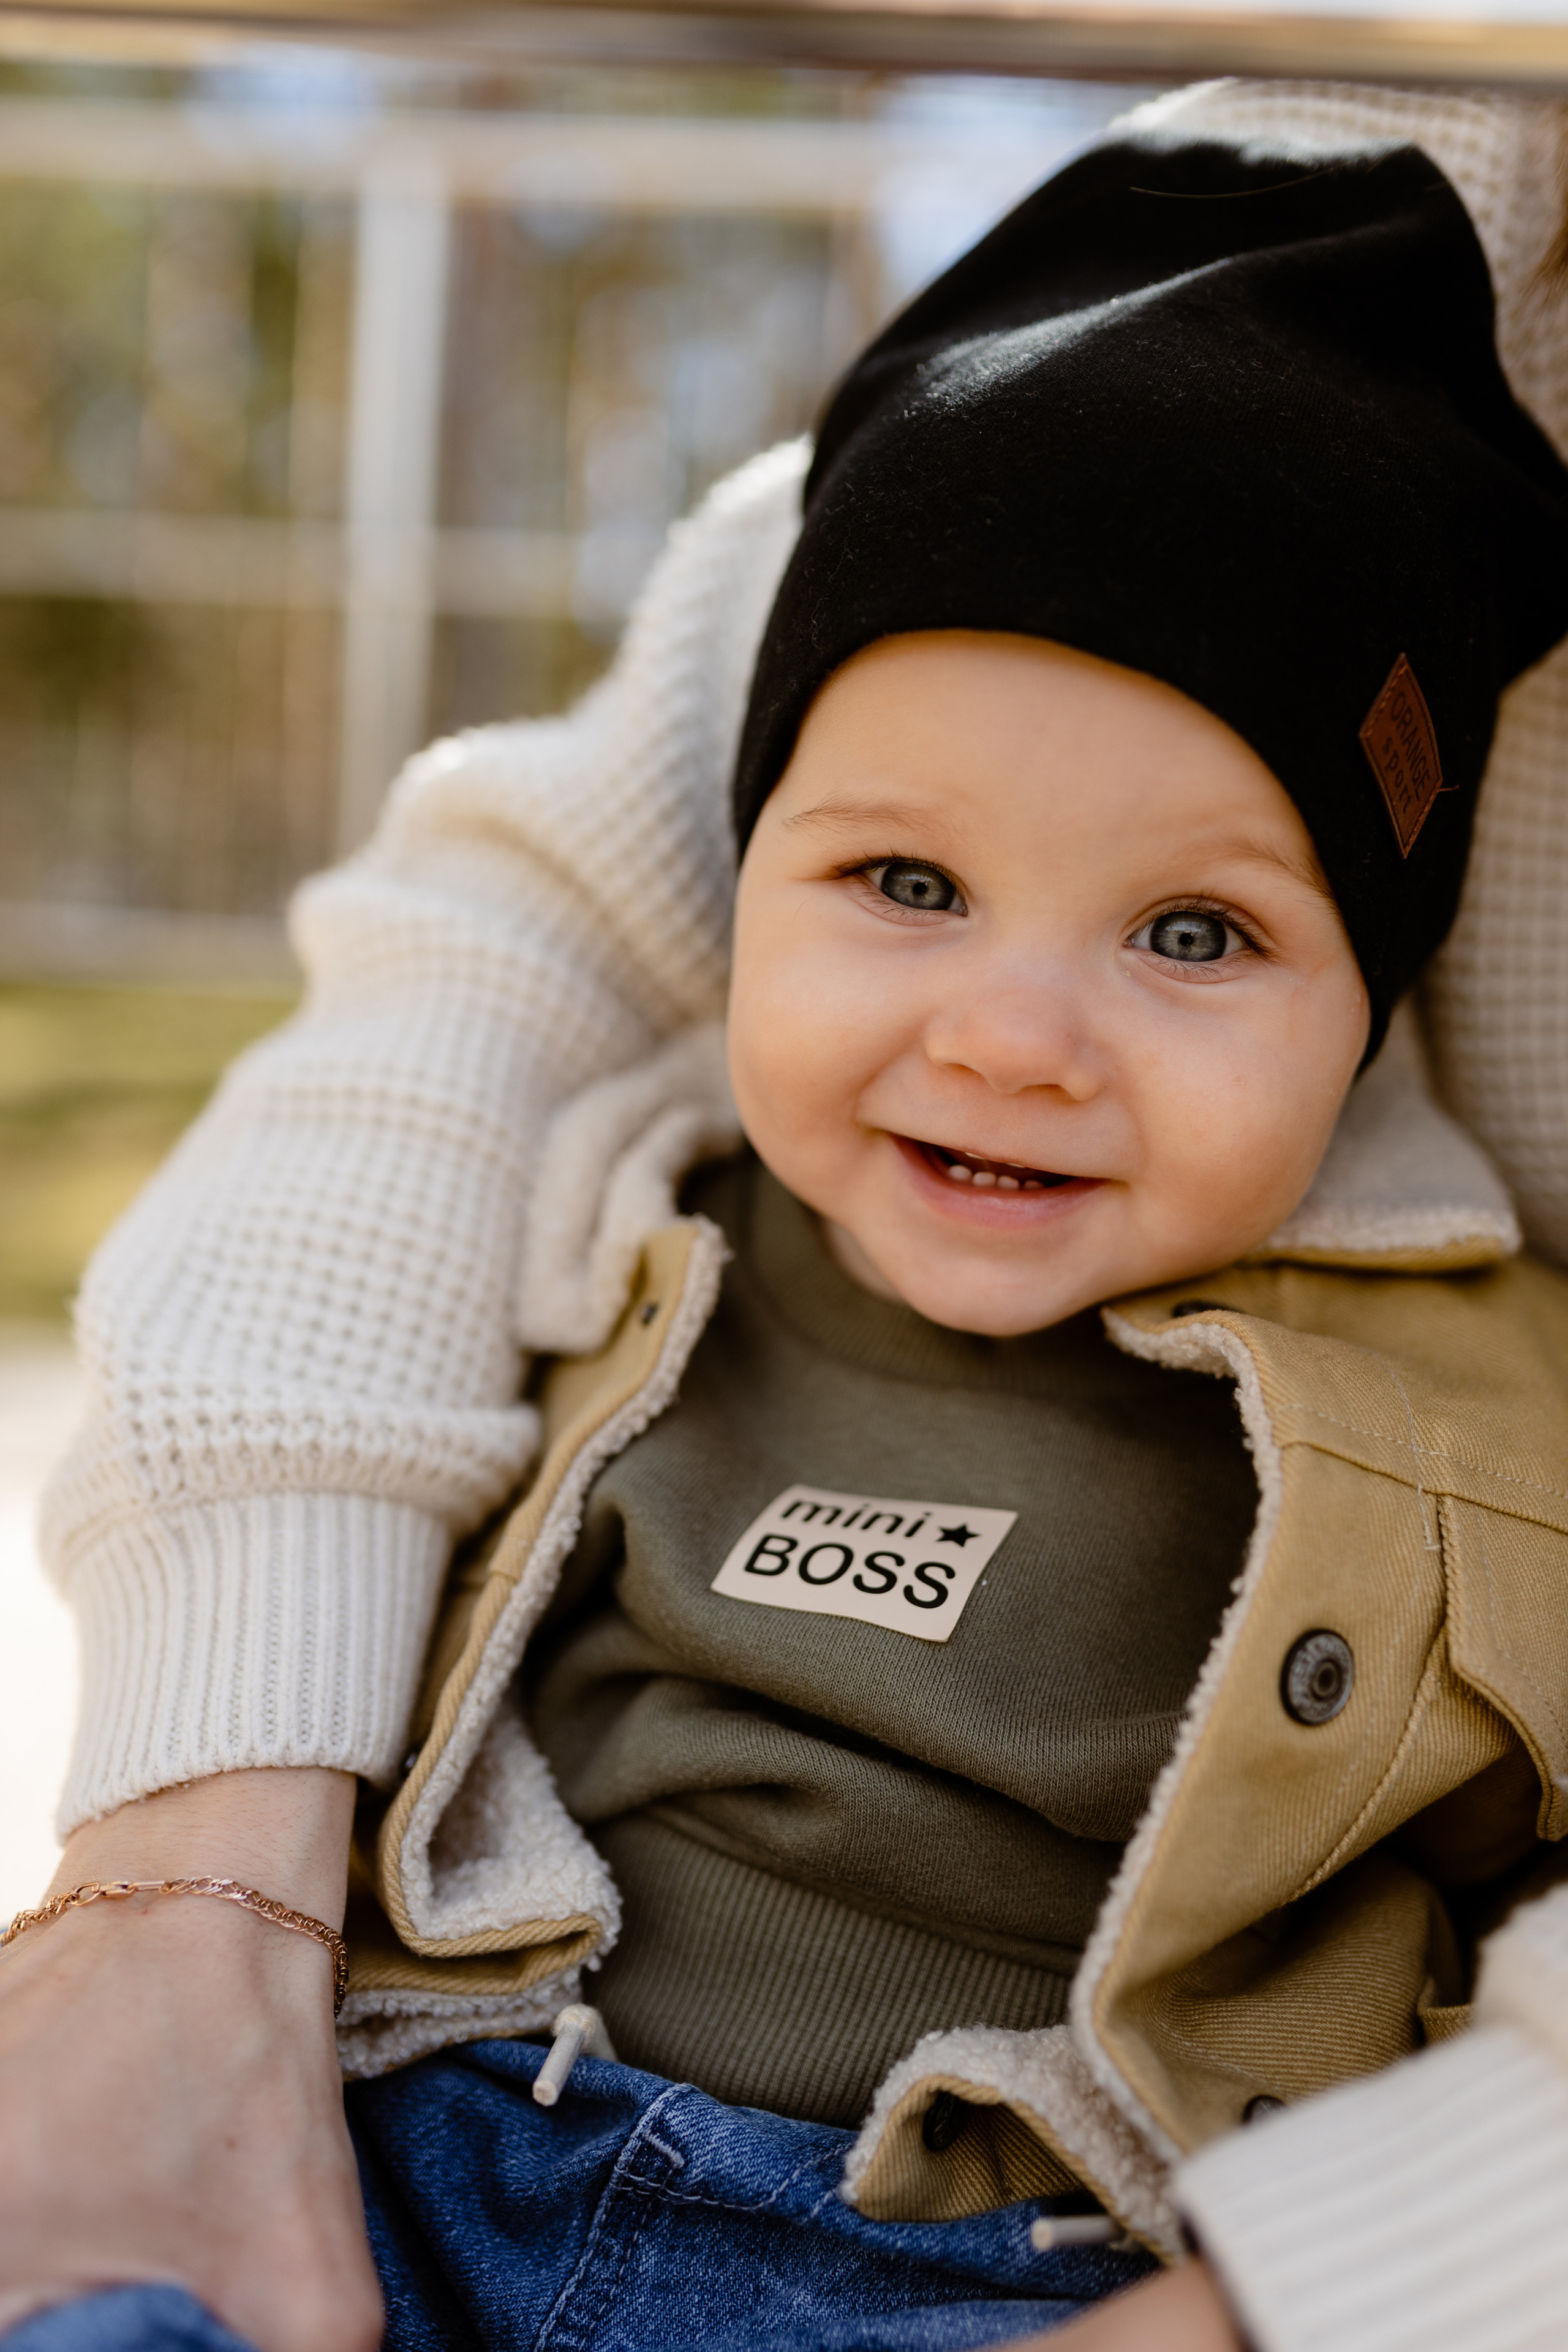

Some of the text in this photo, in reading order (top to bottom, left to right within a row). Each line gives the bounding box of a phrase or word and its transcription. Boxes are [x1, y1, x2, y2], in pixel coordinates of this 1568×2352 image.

[1390, 692, 1430, 801] ORANGE
[781, 1499, 932, 1537] mini
[744, 1534, 956, 1608] BOSS
